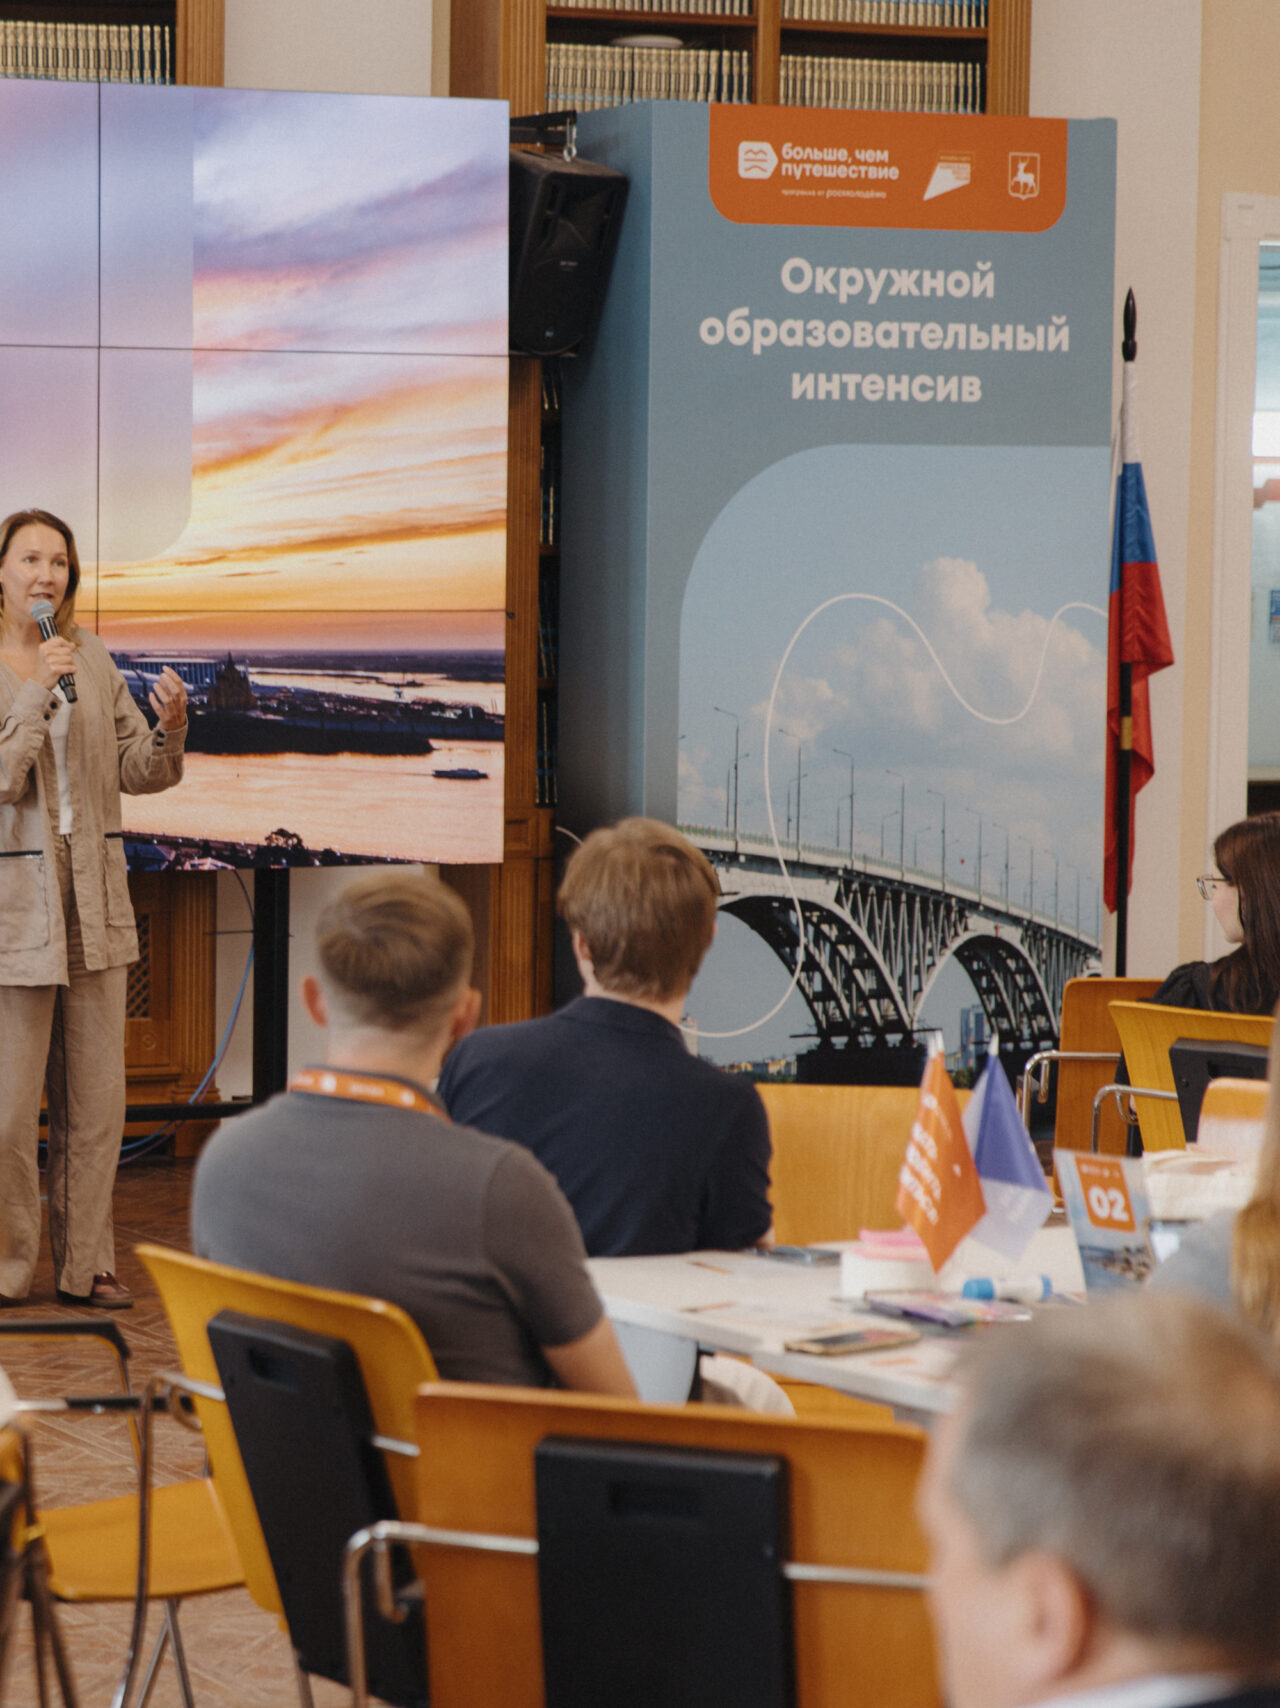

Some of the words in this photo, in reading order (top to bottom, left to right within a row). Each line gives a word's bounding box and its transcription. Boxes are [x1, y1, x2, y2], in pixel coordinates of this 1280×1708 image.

[781, 142, 852, 163] больше,
[854, 149, 889, 163] чем
[781, 163, 899, 180] путешествие
[780, 256, 995, 304] Окружной
[699, 307, 1070, 355] образовательный
[791, 372, 982, 403] интенсив
[1088, 1186, 1130, 1222] 02
